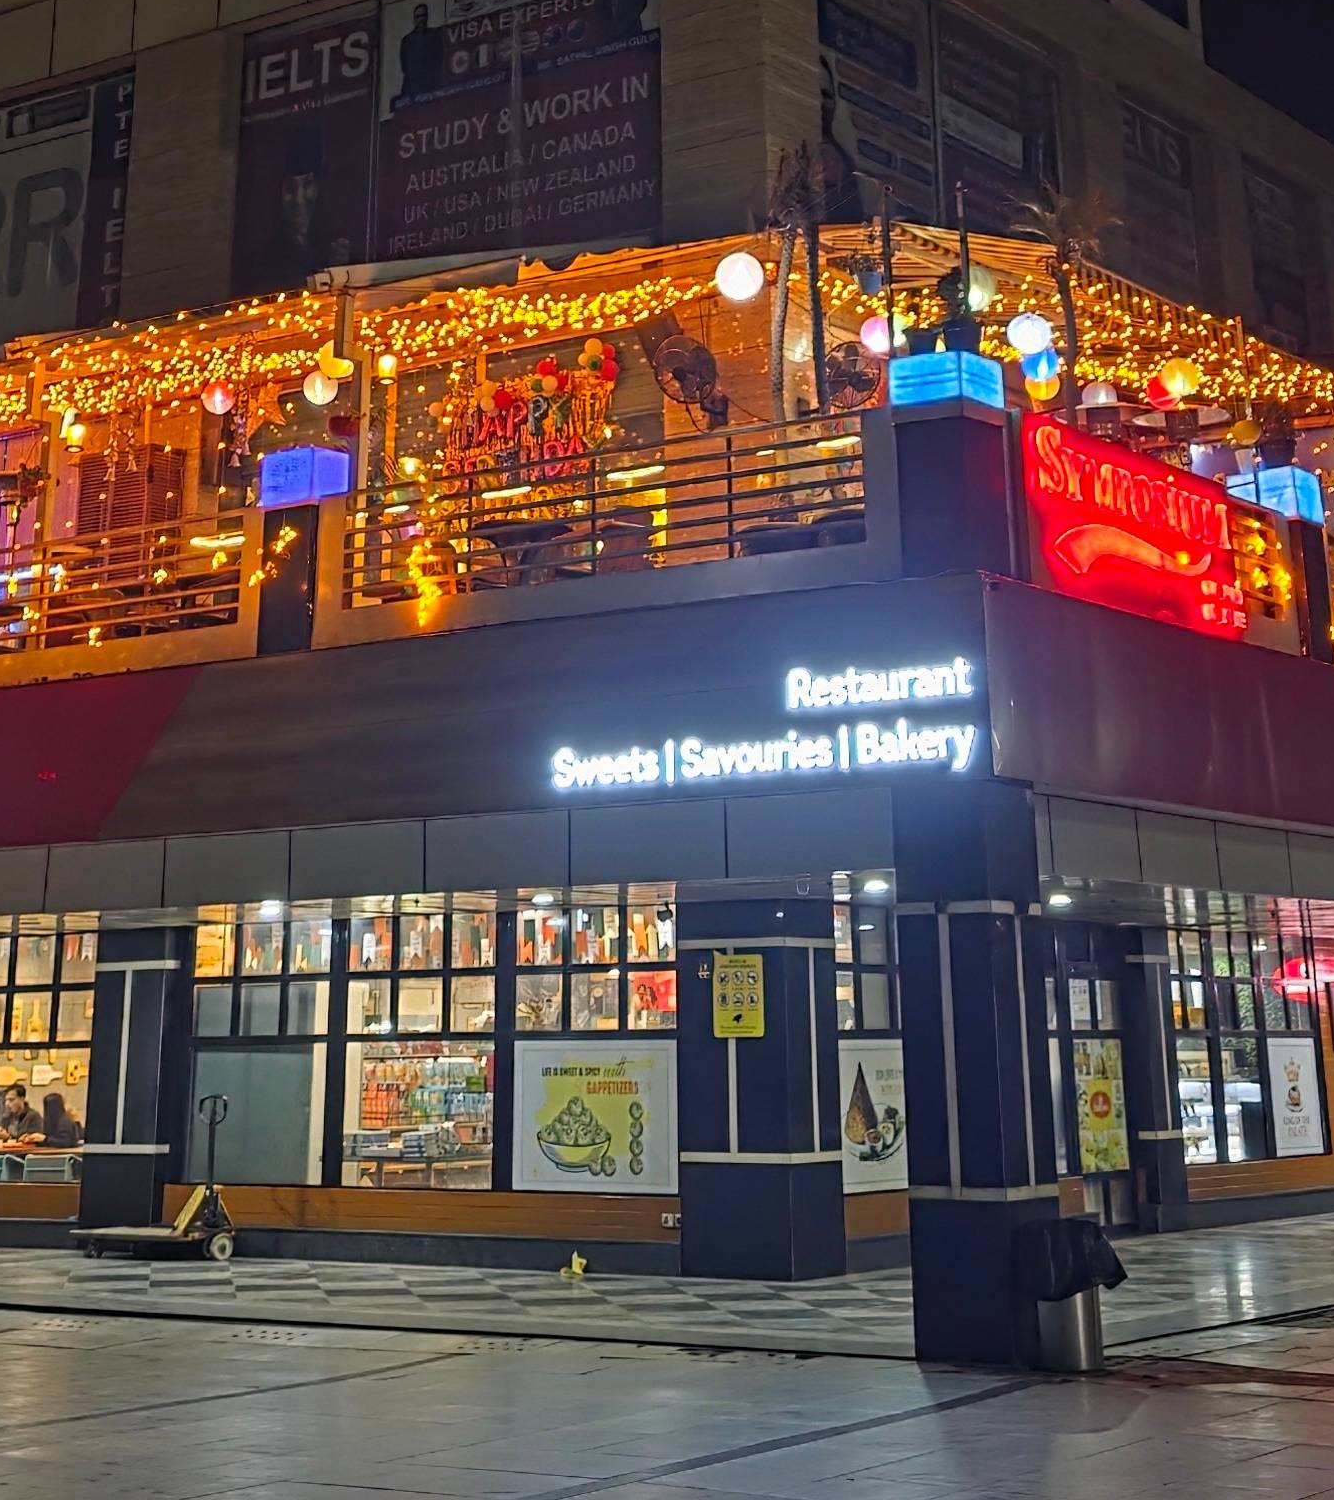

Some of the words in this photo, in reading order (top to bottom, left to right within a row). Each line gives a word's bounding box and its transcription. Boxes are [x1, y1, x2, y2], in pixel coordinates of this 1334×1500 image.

[245, 30, 370, 104] IELTS
[447, 19, 494, 44] VISA
[114, 83, 133, 161] PTE
[398, 112, 489, 160] STUDY
[496, 107, 513, 135] &
[522, 81, 613, 129] WORK
[621, 72, 649, 104] IN
[403, 202, 429, 224] UK
[444, 190, 482, 216] USA
[497, 176, 540, 202] NEW
[544, 155, 636, 192] ZEALAND
[405, 148, 524, 195] AUSTRALIA
[541, 121, 636, 161] CANADA
[388, 220, 468, 255] IRELAND
[483, 203, 542, 234] DUBAI
[558, 179, 656, 217] GERMANY
[1033, 424, 1232, 551] SYMPOSIUM
[786, 655, 973, 710] Restaurant
[551, 745, 661, 790] Sweets
[679, 729, 835, 781] Savouries
[855, 716, 976, 772] Bakery
